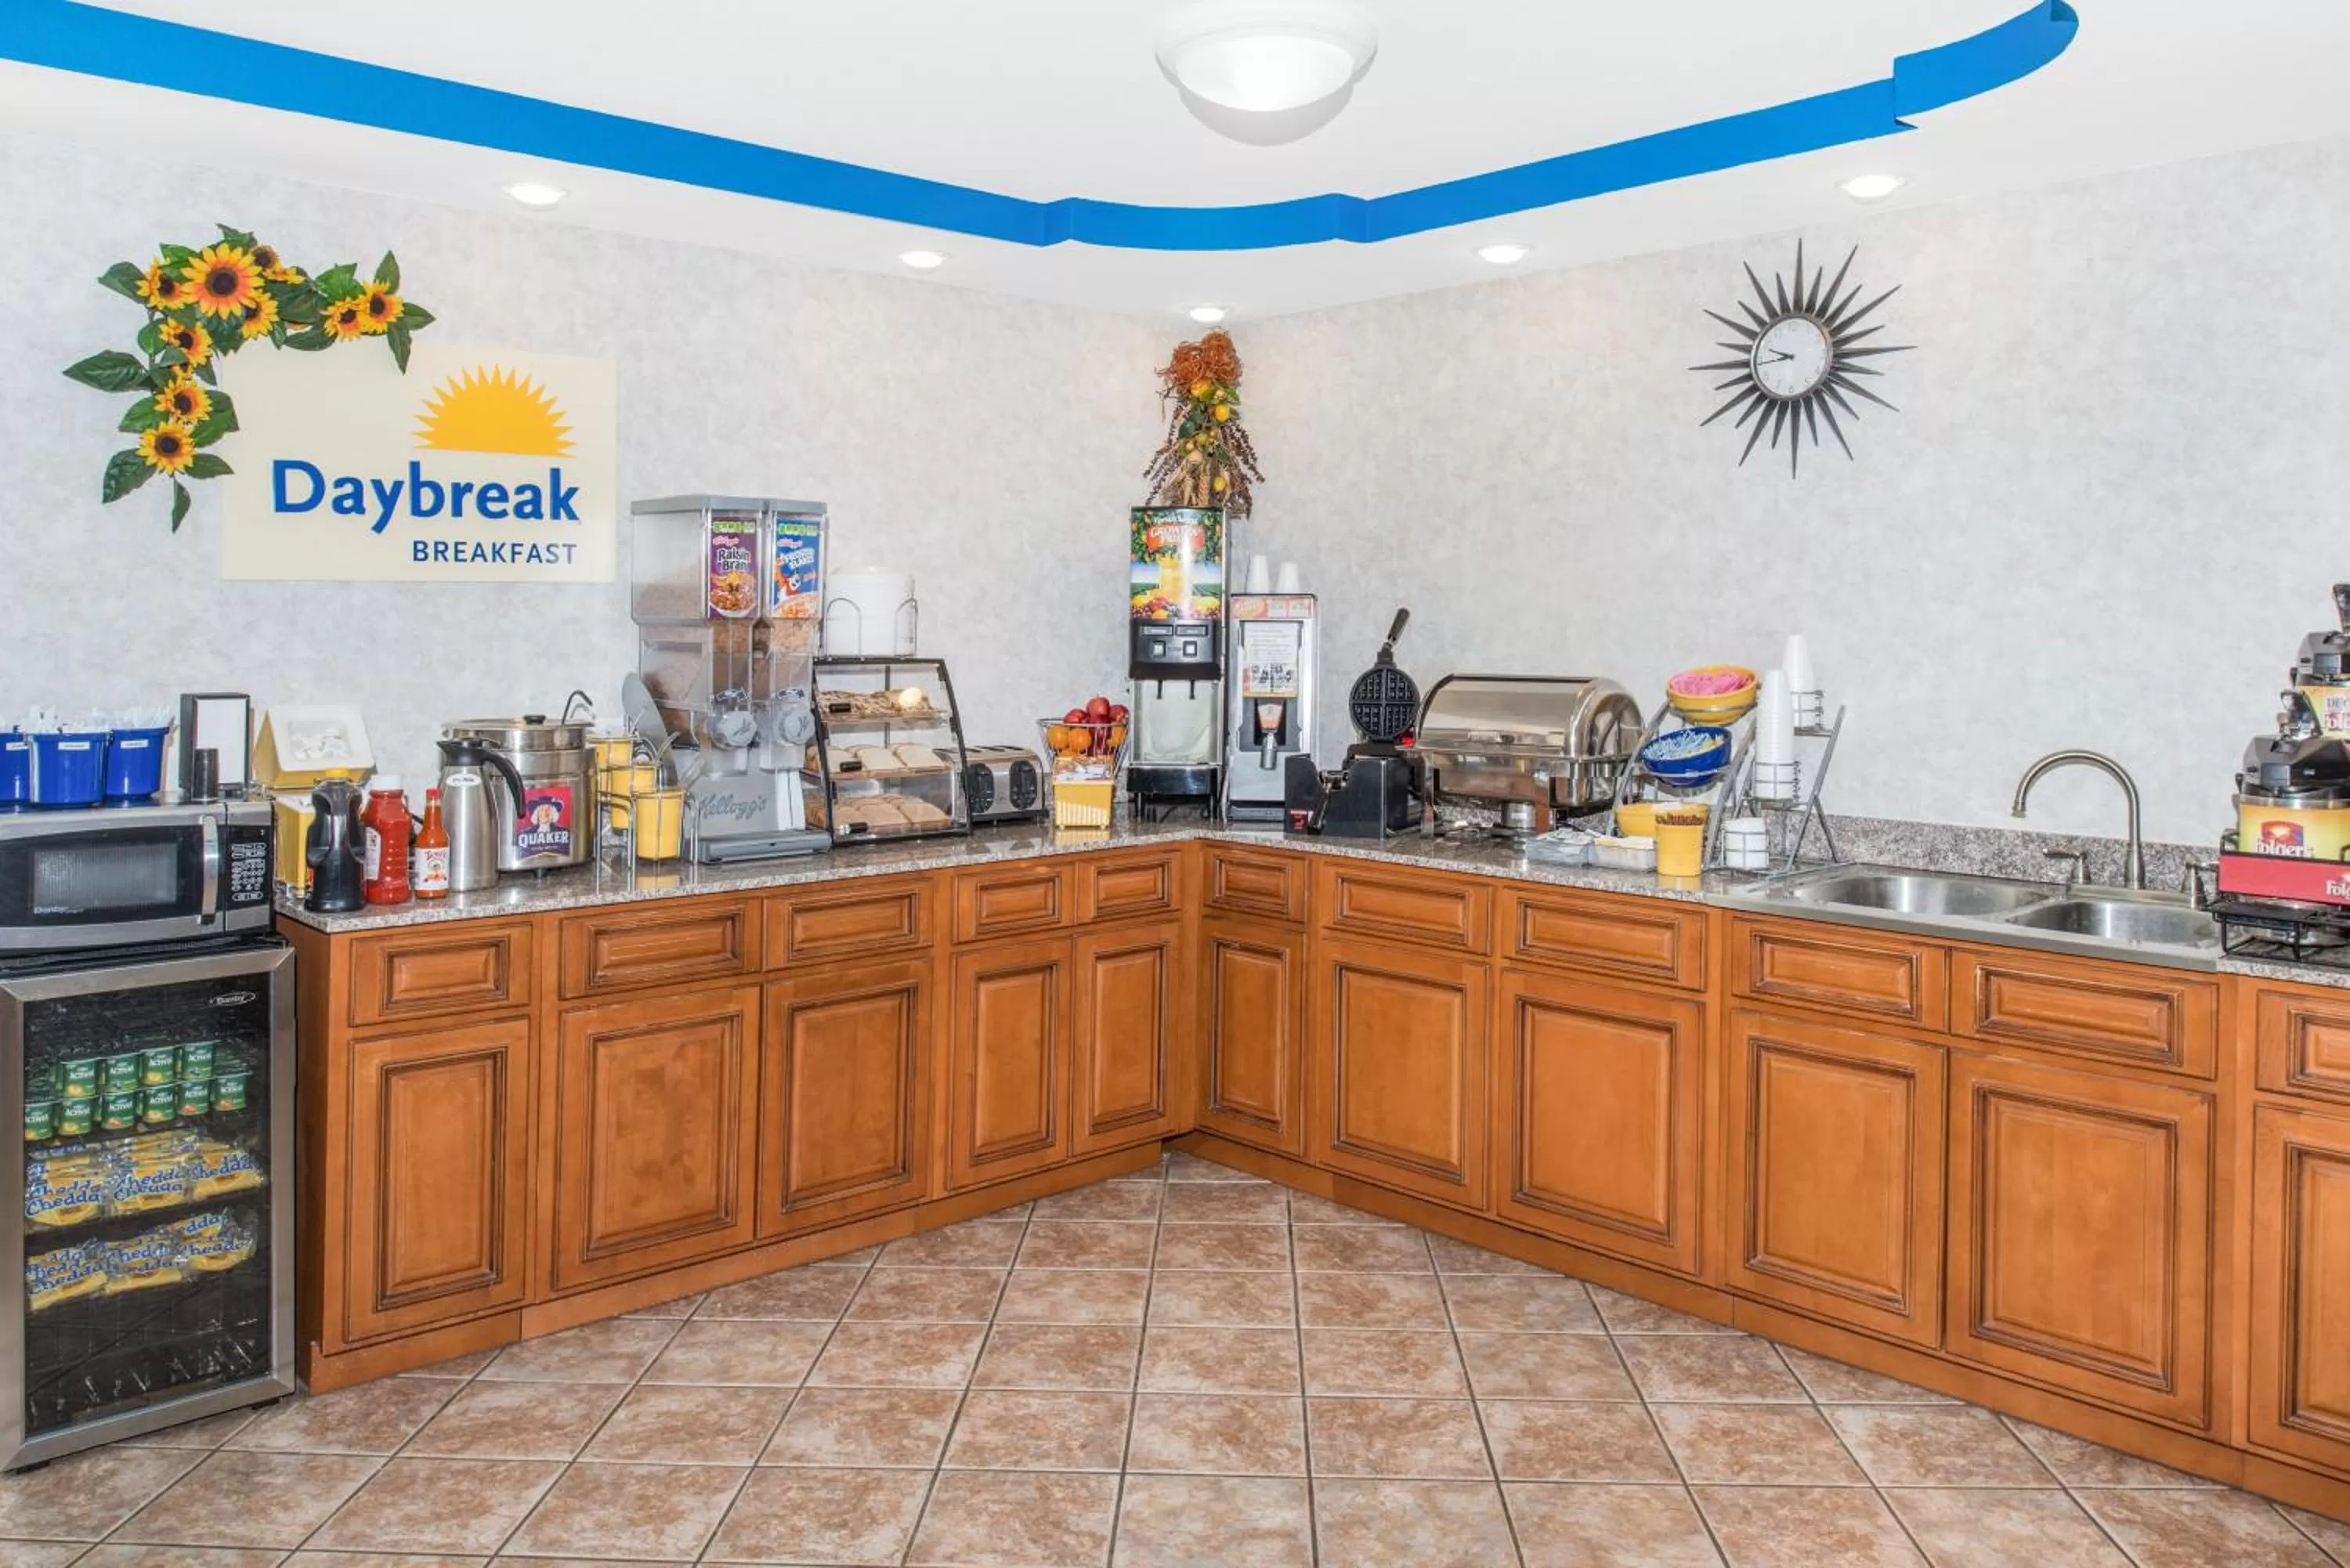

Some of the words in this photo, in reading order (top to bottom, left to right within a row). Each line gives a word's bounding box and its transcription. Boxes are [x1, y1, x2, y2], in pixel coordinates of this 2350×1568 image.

[273, 459, 580, 534] Daybreak
[413, 540, 577, 565] BREAKFAST
[518, 830, 569, 848] QUAKER
